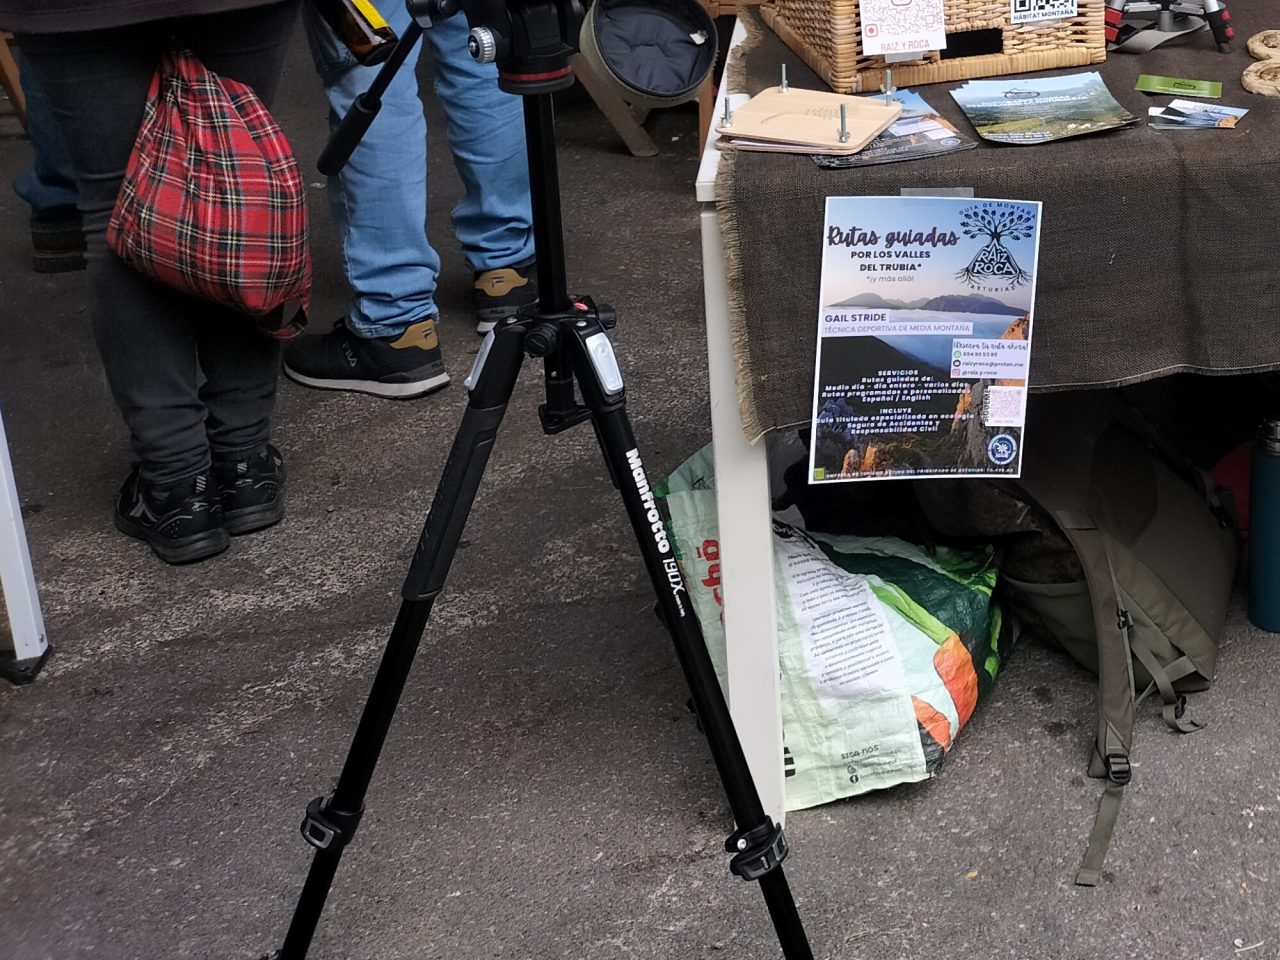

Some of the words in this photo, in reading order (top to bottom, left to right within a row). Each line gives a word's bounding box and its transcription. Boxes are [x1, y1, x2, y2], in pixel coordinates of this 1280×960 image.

[1041, 8, 1074, 18] MONTAÑA
[827, 226, 880, 247] Rutas
[885, 227, 960, 249] guiadas
[851, 251, 872, 259] POR
[874, 251, 893, 259] LOS
[894, 250, 931, 259] VALLES
[859, 264, 878, 272] DEL
[973, 262, 1016, 275] ROCA
[824, 315, 849, 323] GAIL
[851, 313, 887, 322] STRIDE
[824, 325, 856, 334] TÉCNICA
[857, 325, 897, 333] DEPORTIVA
[899, 324, 908, 332] DE
[909, 324, 932, 332] MEDIA
[933, 323, 970, 332] MONTAÑA
[886, 376, 919, 384] guiadas
[625, 447, 670, 554] Manfrotto
